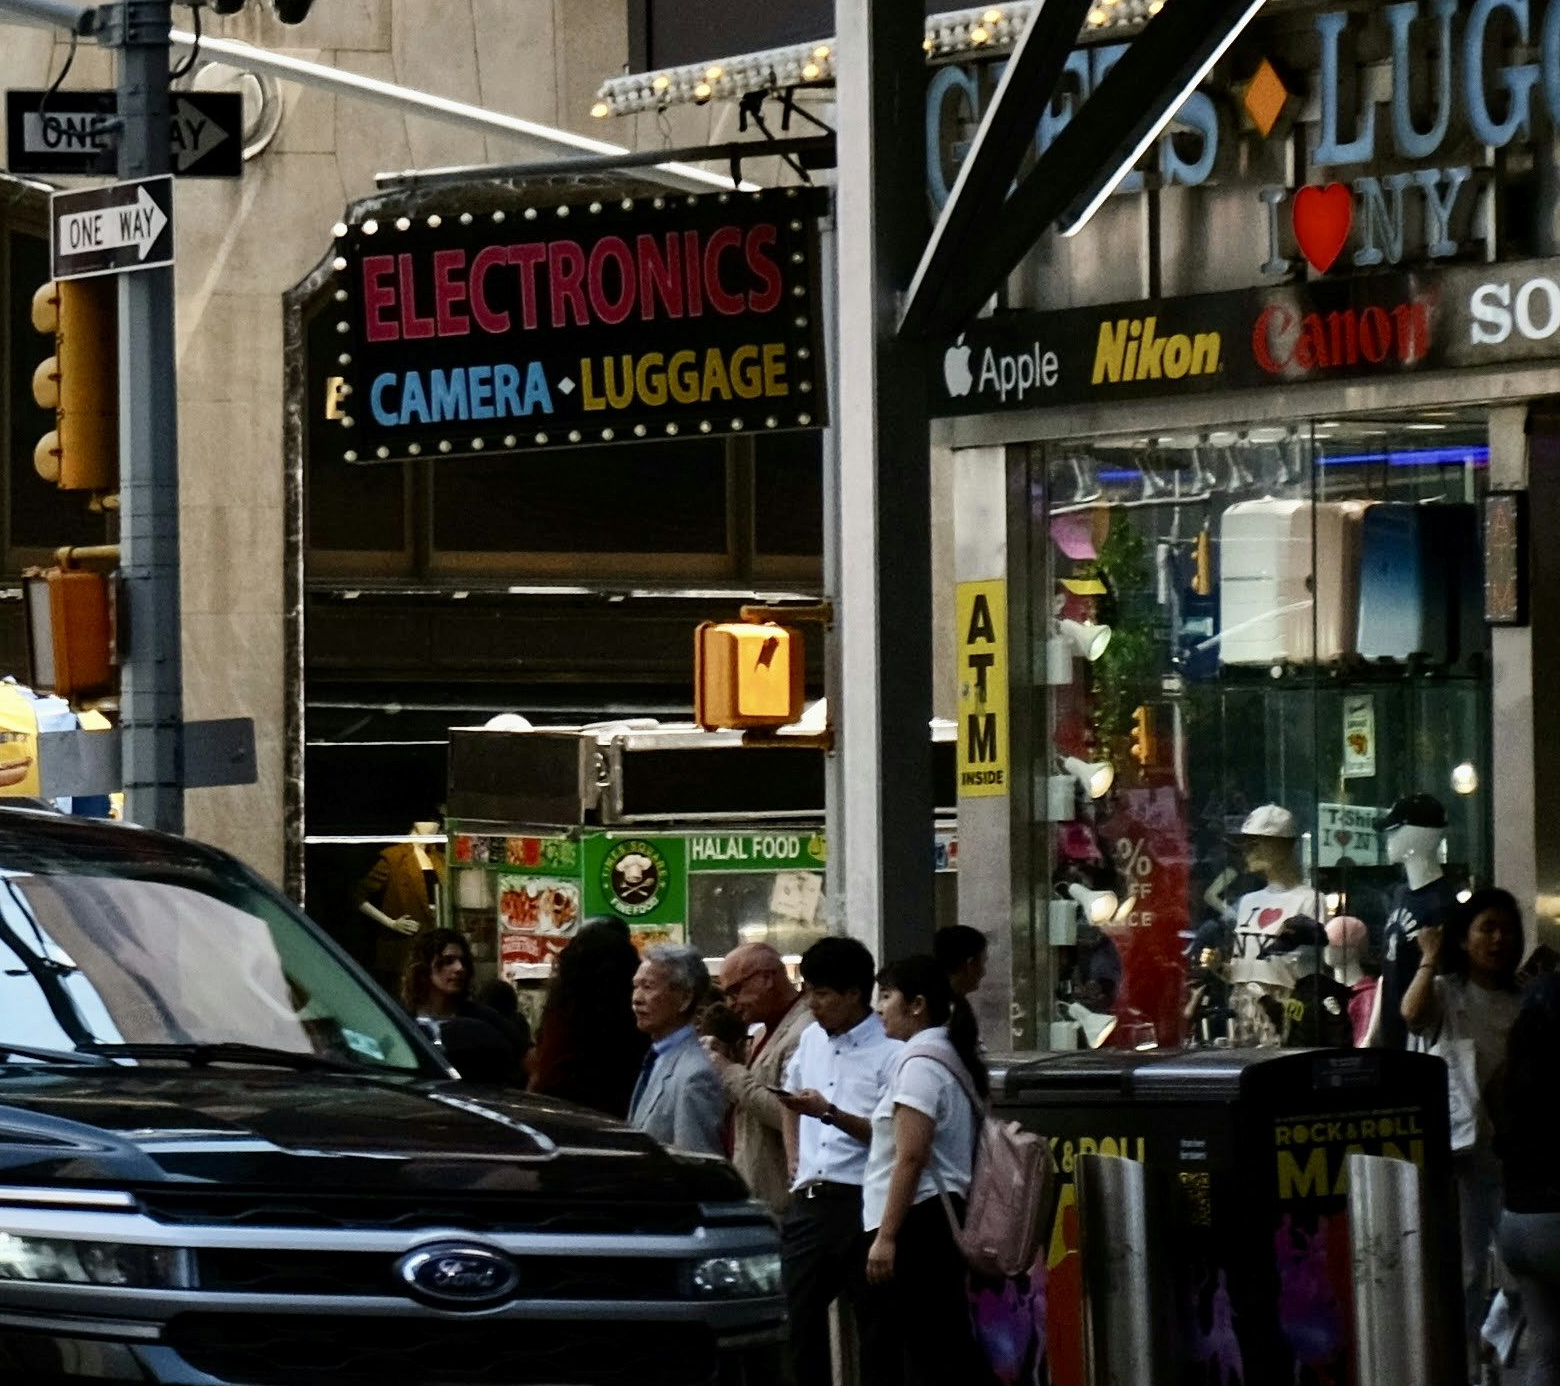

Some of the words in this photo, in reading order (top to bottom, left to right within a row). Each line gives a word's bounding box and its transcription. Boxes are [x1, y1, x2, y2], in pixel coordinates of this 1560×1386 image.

[41, 115, 108, 150] ONE
[69, 211, 104, 252] ONE
[119, 203, 155, 243] WAY
[1260, 187, 1289, 275] I
[1353, 165, 1471, 267] NY
[363, 222, 783, 343] ELECTRONICS
[370, 360, 555, 427] CAMERA
[580, 341, 790, 412] LUGGAGE
[978, 341, 1059, 404] Apple
[1091, 316, 1221, 387] Nikon
[1252, 297, 1434, 376] Canon
[968, 593, 998, 765] ATM
[961, 769, 1004, 786] INSIDE
[692, 835, 749, 862] HALAL
[752, 834, 801, 861] FOOD
[1240, 907, 1260, 928] I
